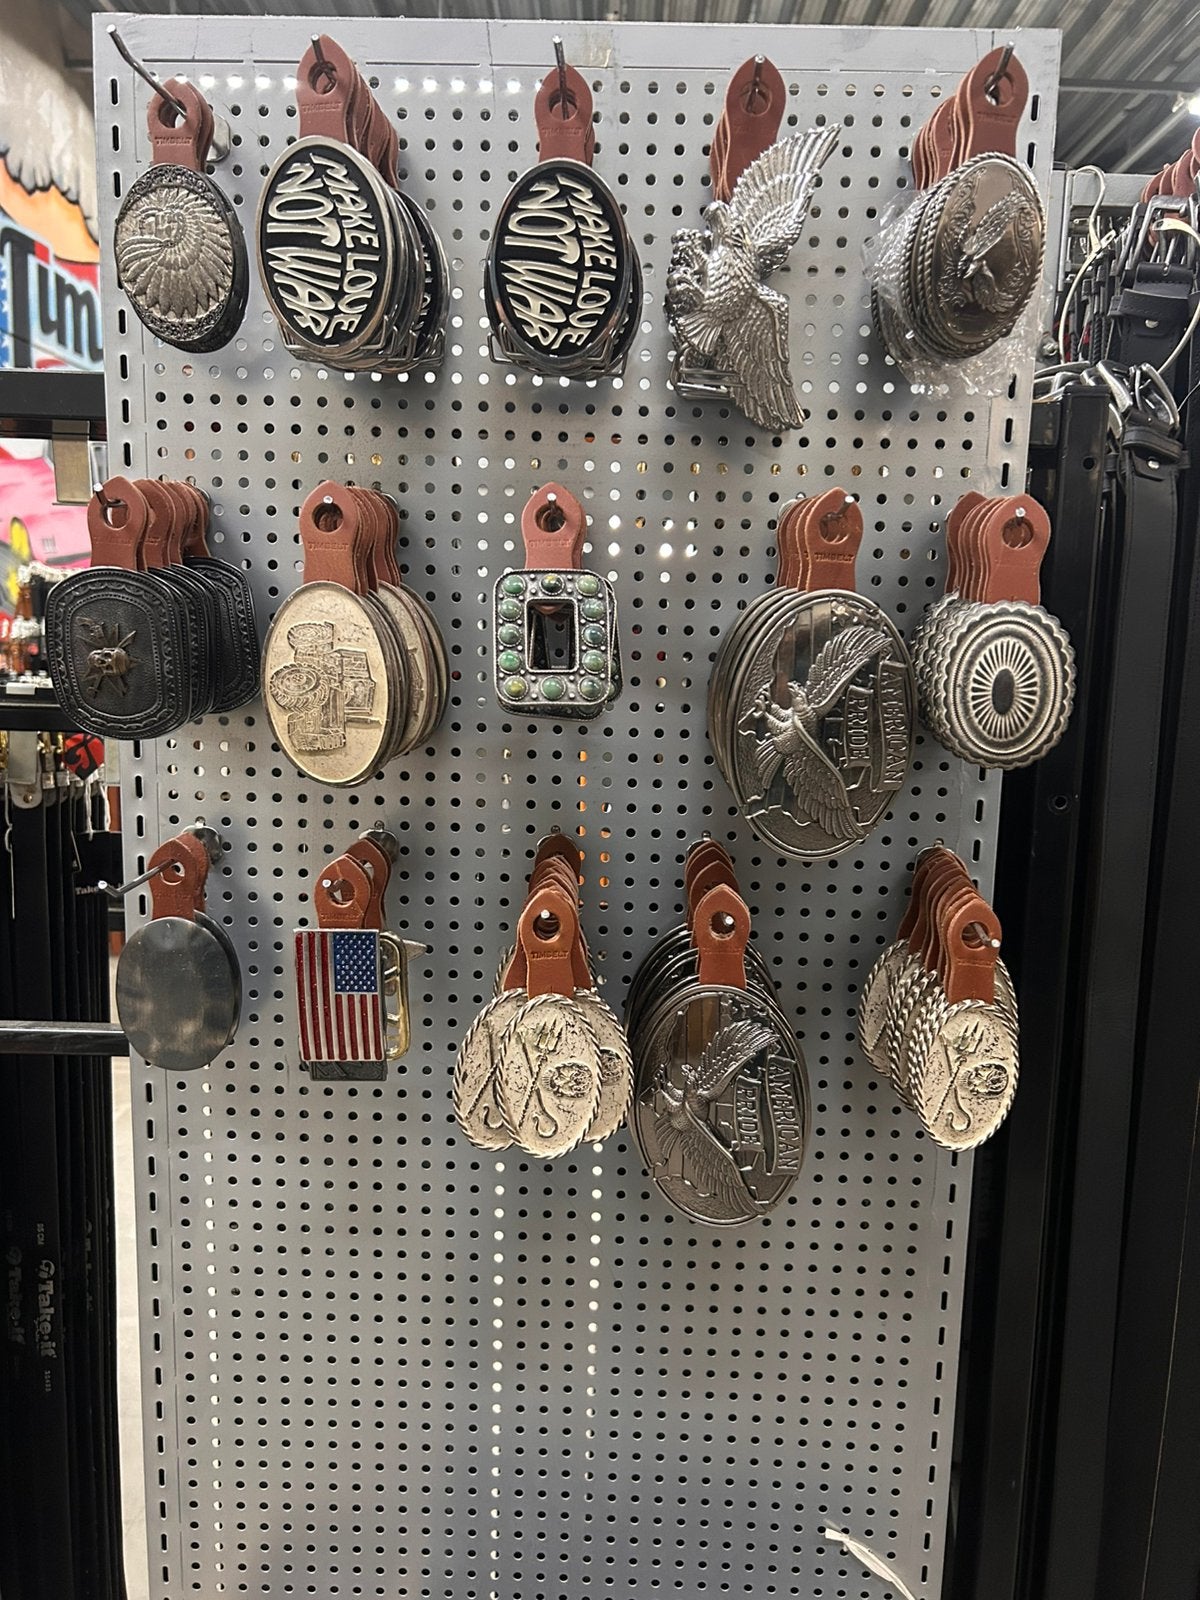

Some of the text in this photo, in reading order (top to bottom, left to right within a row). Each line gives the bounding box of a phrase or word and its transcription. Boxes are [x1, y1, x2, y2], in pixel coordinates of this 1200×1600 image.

[265, 162, 342, 336] NOT WAR
[309, 153, 381, 339] MAKE LOVE
[500, 181, 581, 346] NOT WAR
[550, 174, 617, 350] MAKE LOVE
[848, 698, 870, 759] PRIDE
[880, 671, 908, 784] AMERICAN
[737, 1089, 761, 1145] PRIDE
[768, 1064, 800, 1170] AMERICAN
